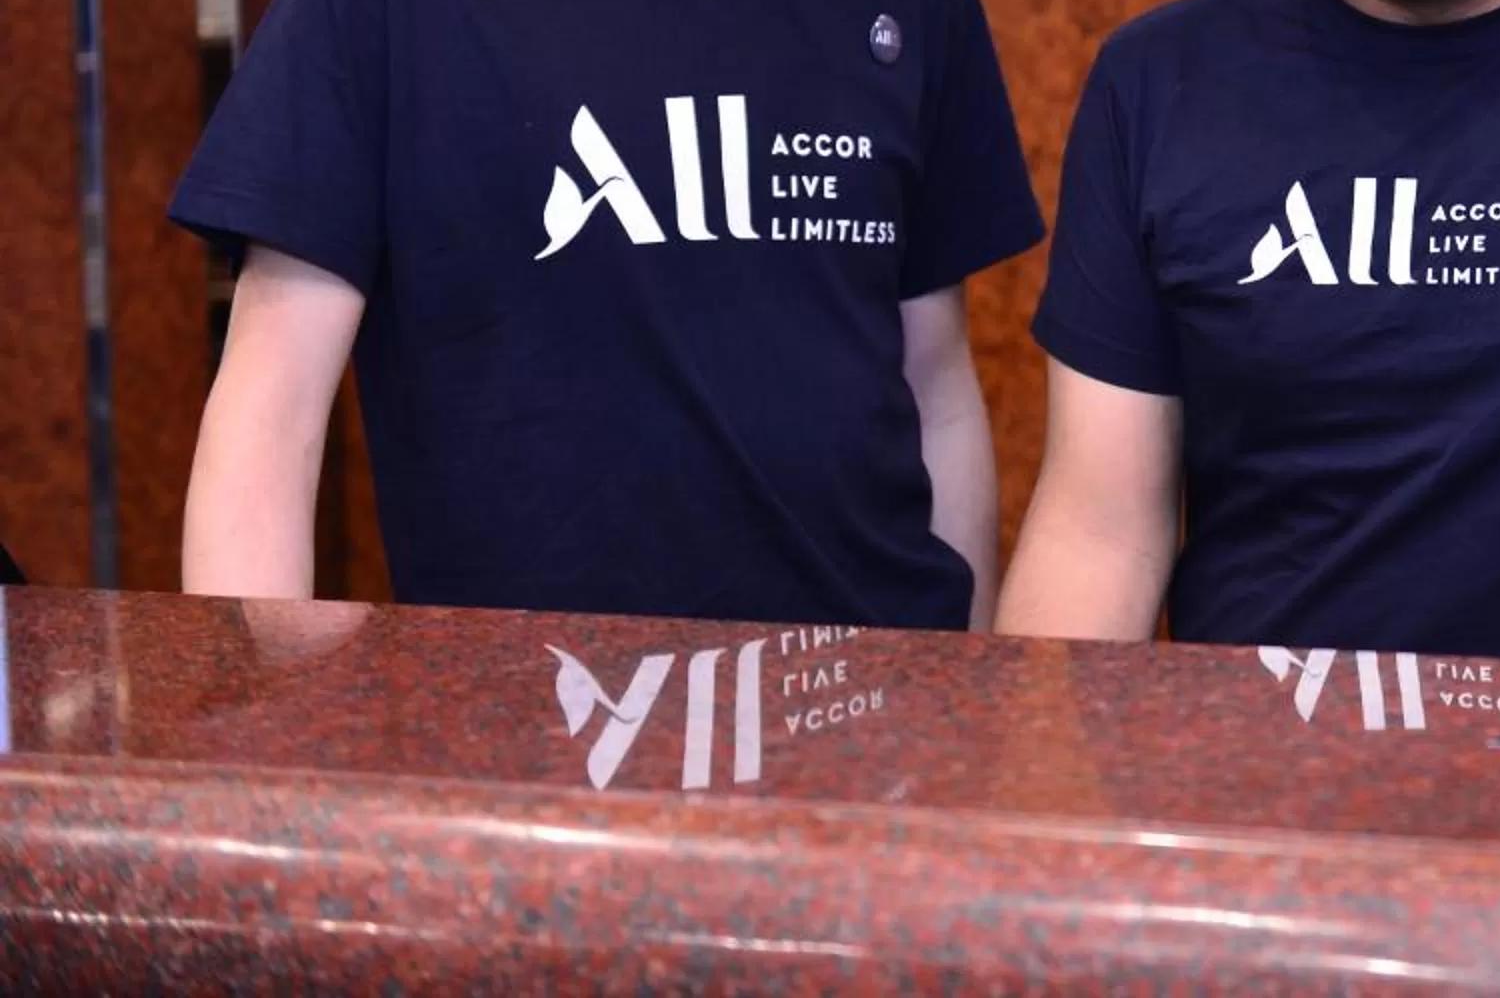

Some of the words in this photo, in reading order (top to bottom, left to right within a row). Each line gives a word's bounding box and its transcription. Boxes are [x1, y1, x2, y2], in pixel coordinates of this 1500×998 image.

[772, 133, 871, 158] ACCOR
[772, 175, 837, 198] LIVE
[772, 218, 895, 243] LIMITLESS
[1430, 235, 1486, 253] LIVE
